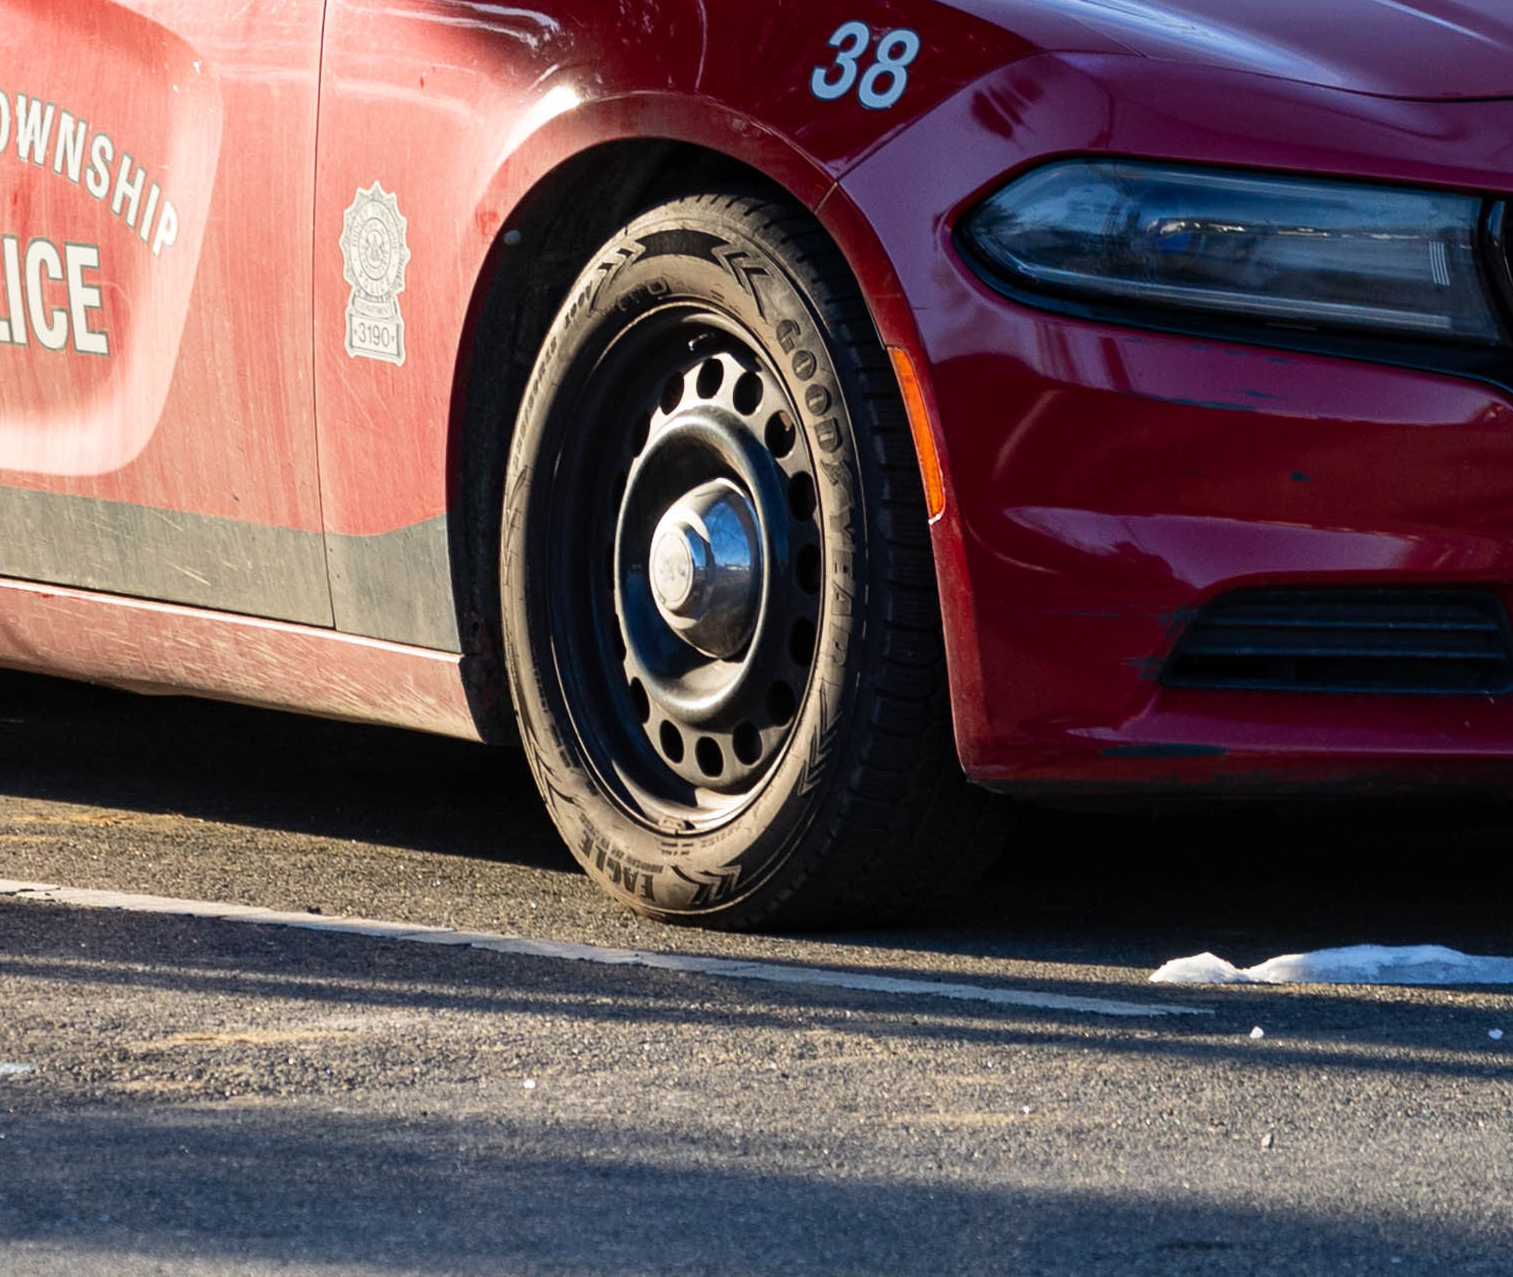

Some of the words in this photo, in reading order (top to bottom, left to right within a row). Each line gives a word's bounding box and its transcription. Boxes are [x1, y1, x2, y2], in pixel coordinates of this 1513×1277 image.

[811, 21, 920, 109] 38
[358, 322, 390, 348] 3190
[579, 829, 656, 902] EAGLE
